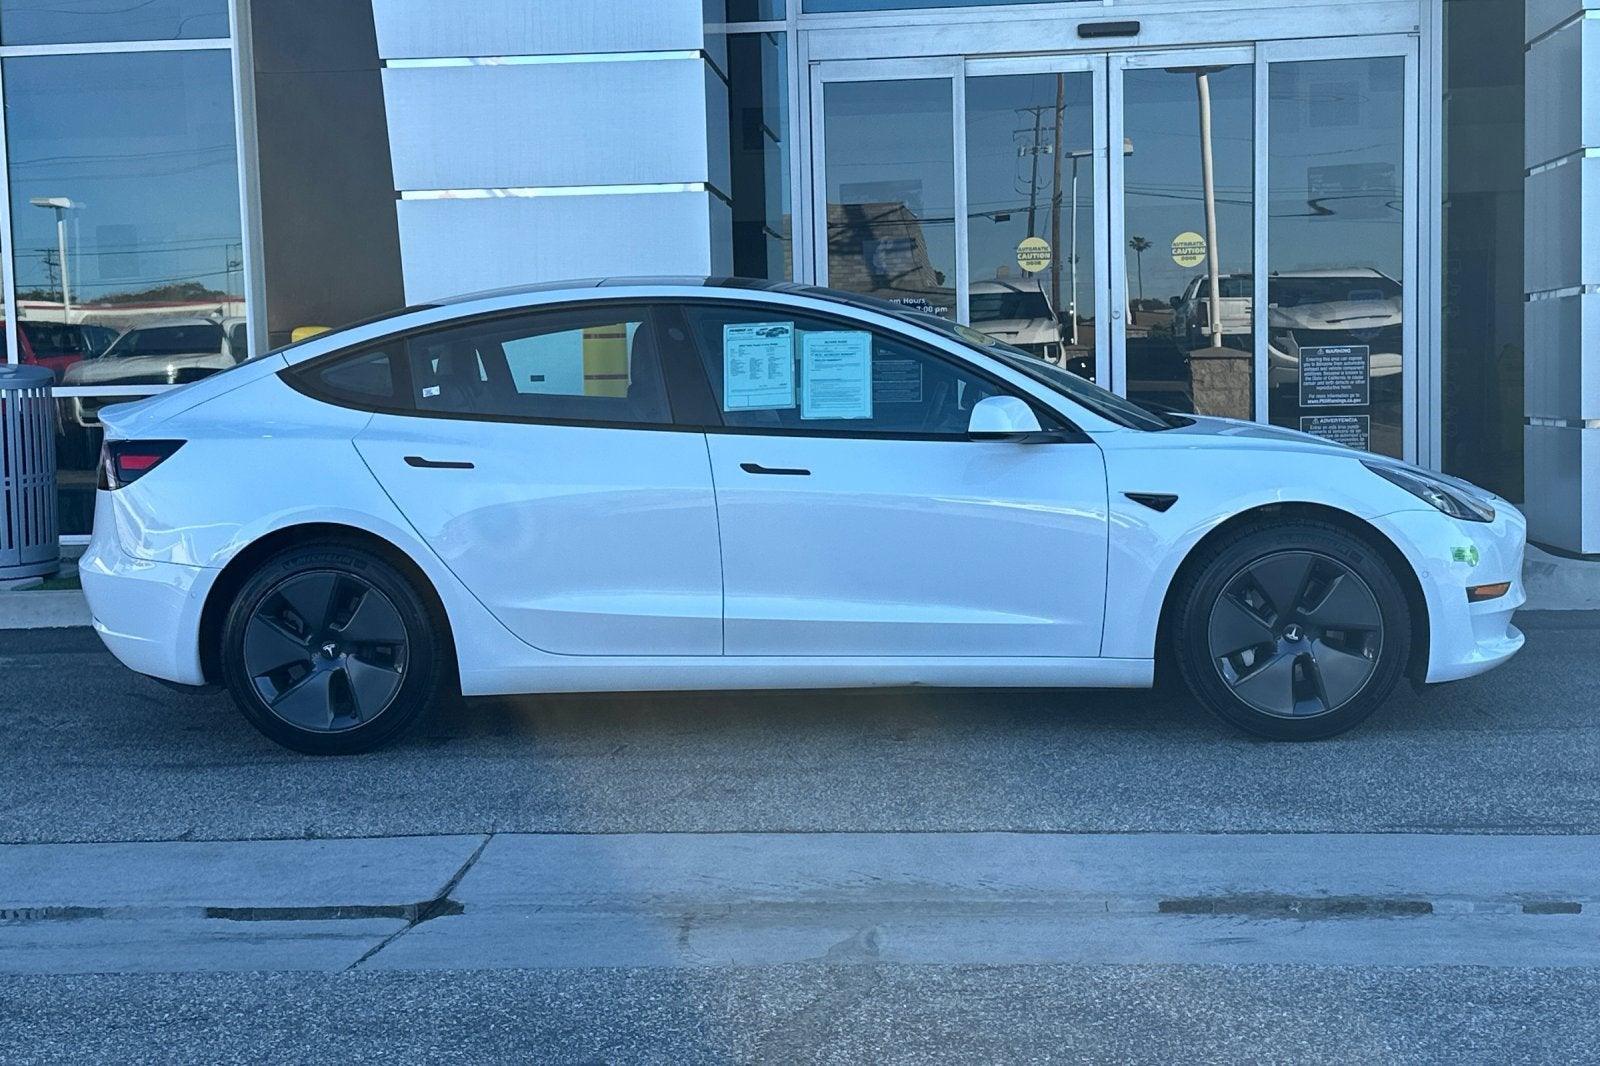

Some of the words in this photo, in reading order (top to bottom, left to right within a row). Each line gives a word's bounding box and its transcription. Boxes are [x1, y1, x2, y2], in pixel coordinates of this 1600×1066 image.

[1171, 247, 1206, 255] CAUTION
[1017, 252, 1050, 260] CAUTION
[935, 306, 948, 314] pm
